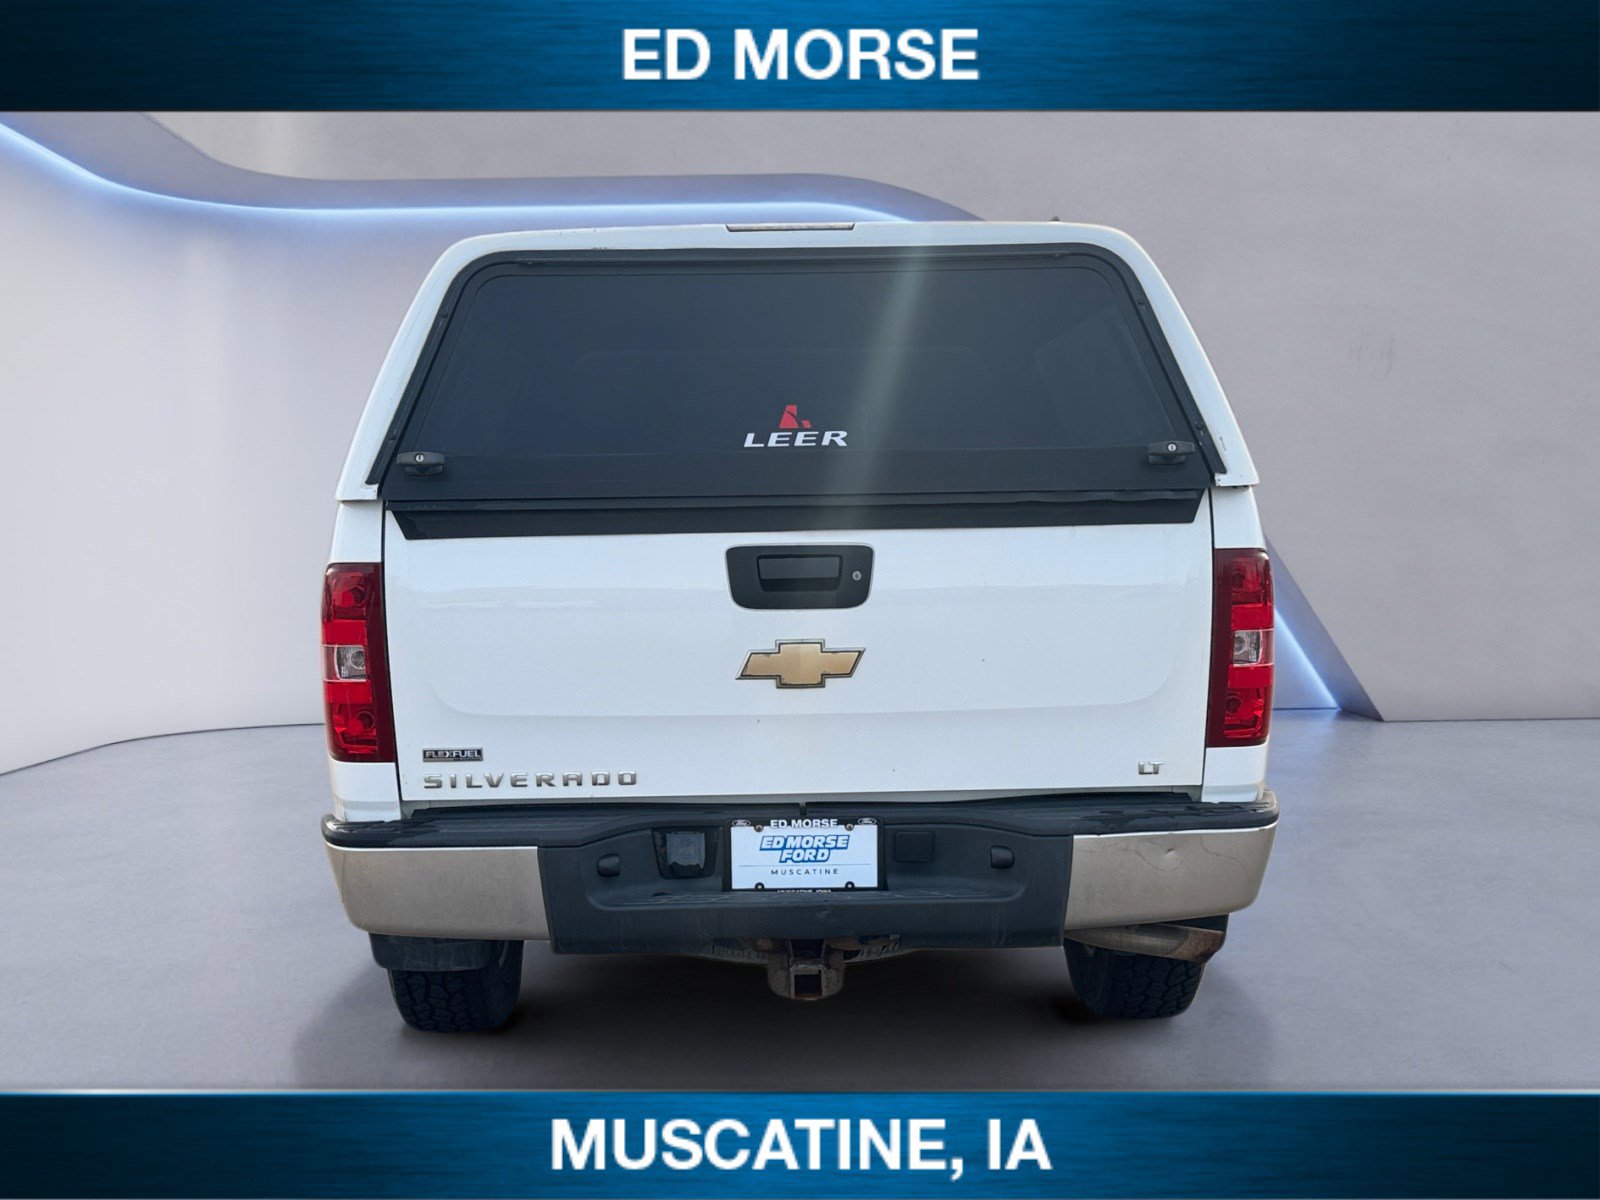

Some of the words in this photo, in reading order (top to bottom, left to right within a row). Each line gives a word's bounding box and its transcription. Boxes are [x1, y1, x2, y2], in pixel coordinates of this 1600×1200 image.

[743, 430, 848, 448] LEER
[425, 749, 482, 759] FLEXFUEL
[1138, 761, 1165, 775] LT
[423, 771, 638, 789] SILVERADO
[770, 819, 787, 829] ED
[791, 818, 838, 828] MORSE
[760, 836, 787, 850] ED
[786, 835, 850, 850] MORSE
[780, 849, 831, 863] FORD
[770, 868, 839, 876] MUSCATINE
